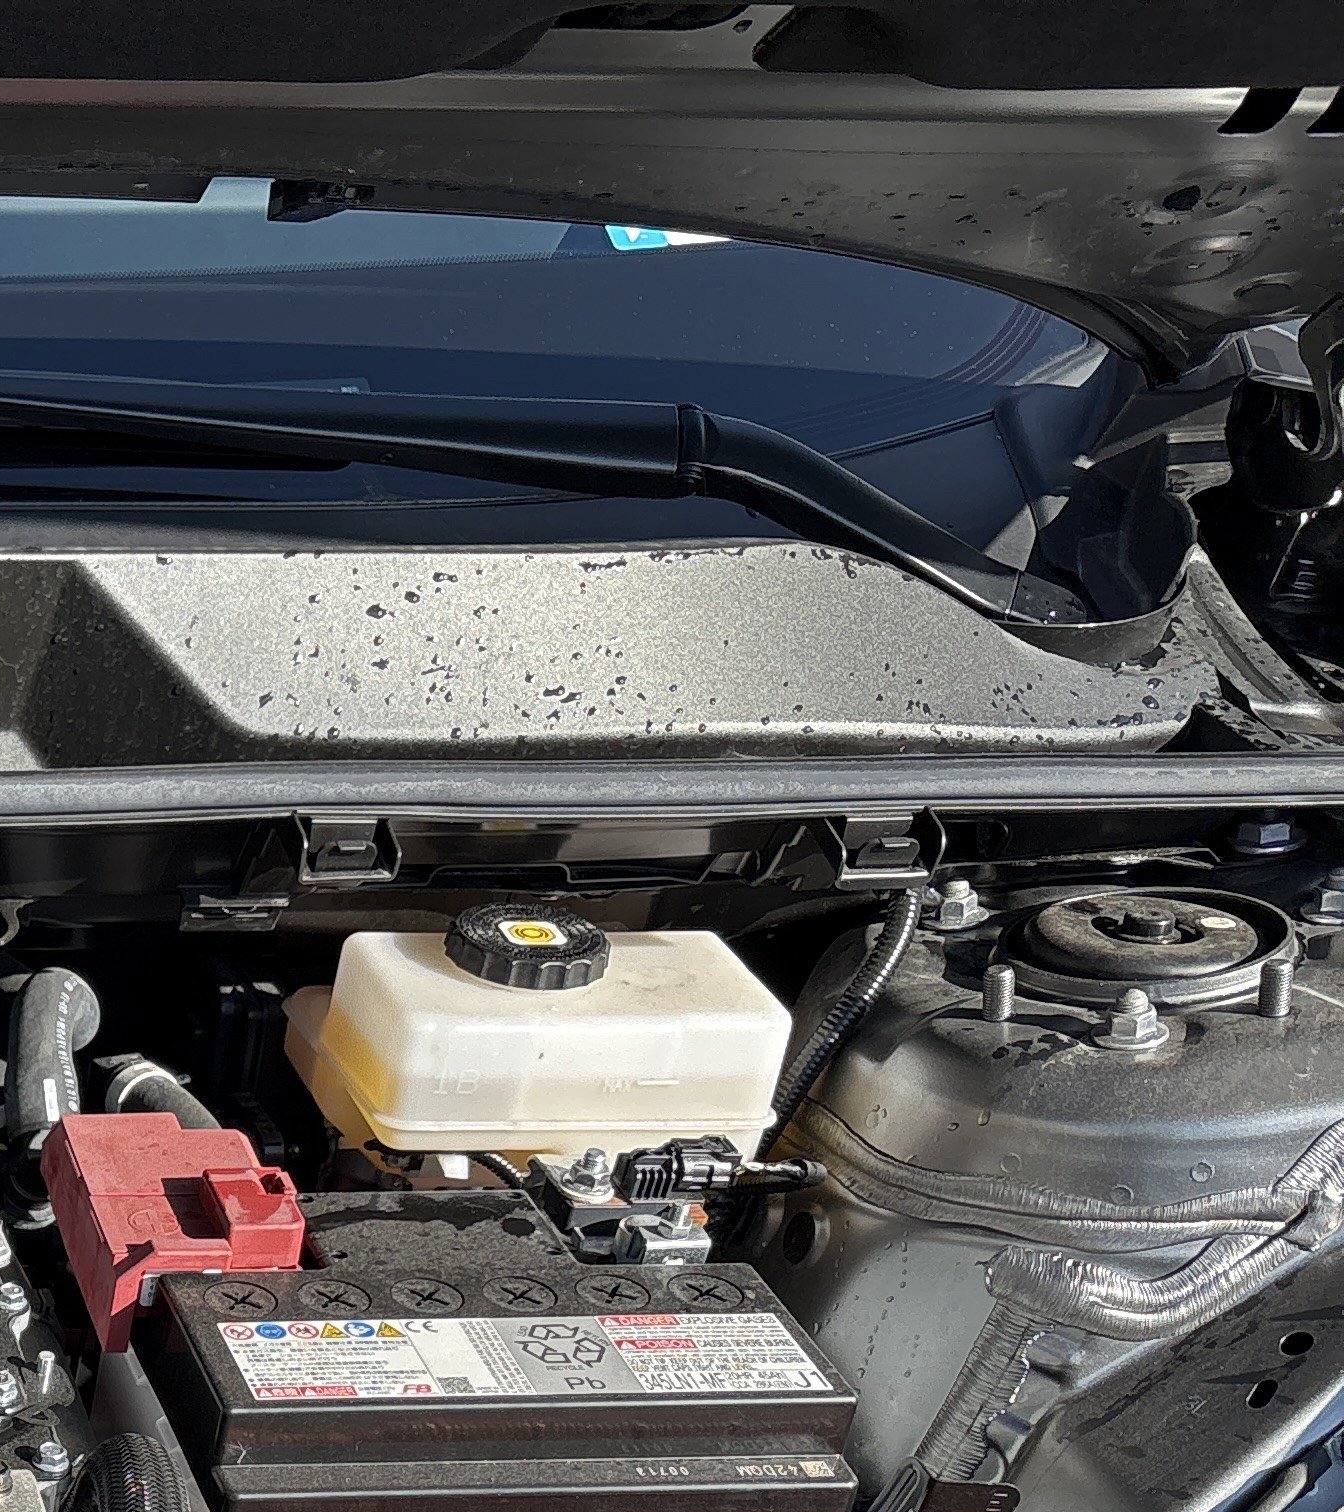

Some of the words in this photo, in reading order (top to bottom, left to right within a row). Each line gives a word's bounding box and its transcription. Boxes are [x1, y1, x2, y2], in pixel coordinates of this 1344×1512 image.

[405, 1320, 438, 1333] CE
[618, 1316, 676, 1326] DANGER
[680, 1316, 737, 1325] EXPLOSIVE
[403, 1384, 432, 1393] FB
[564, 1377, 606, 1390] Pb
